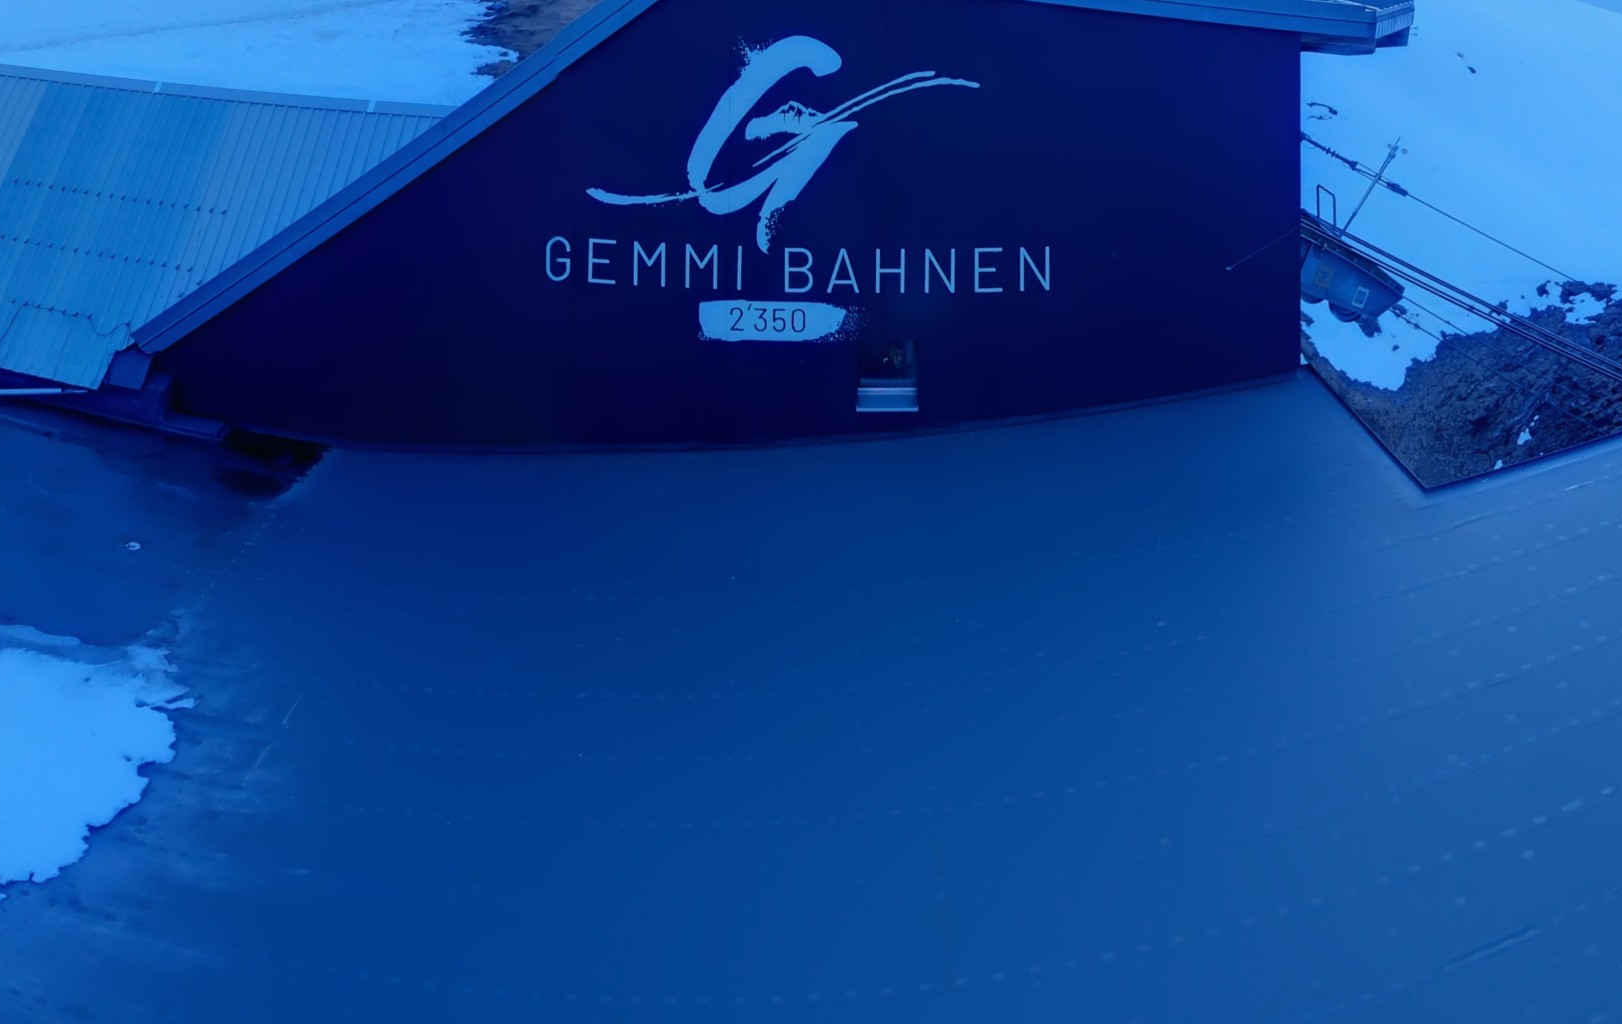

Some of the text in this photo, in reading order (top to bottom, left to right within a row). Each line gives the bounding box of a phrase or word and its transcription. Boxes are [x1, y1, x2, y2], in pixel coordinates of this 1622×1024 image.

[545, 236, 1050, 294] GEMMI BAHNEN
[729, 303, 806, 333] 2'350
